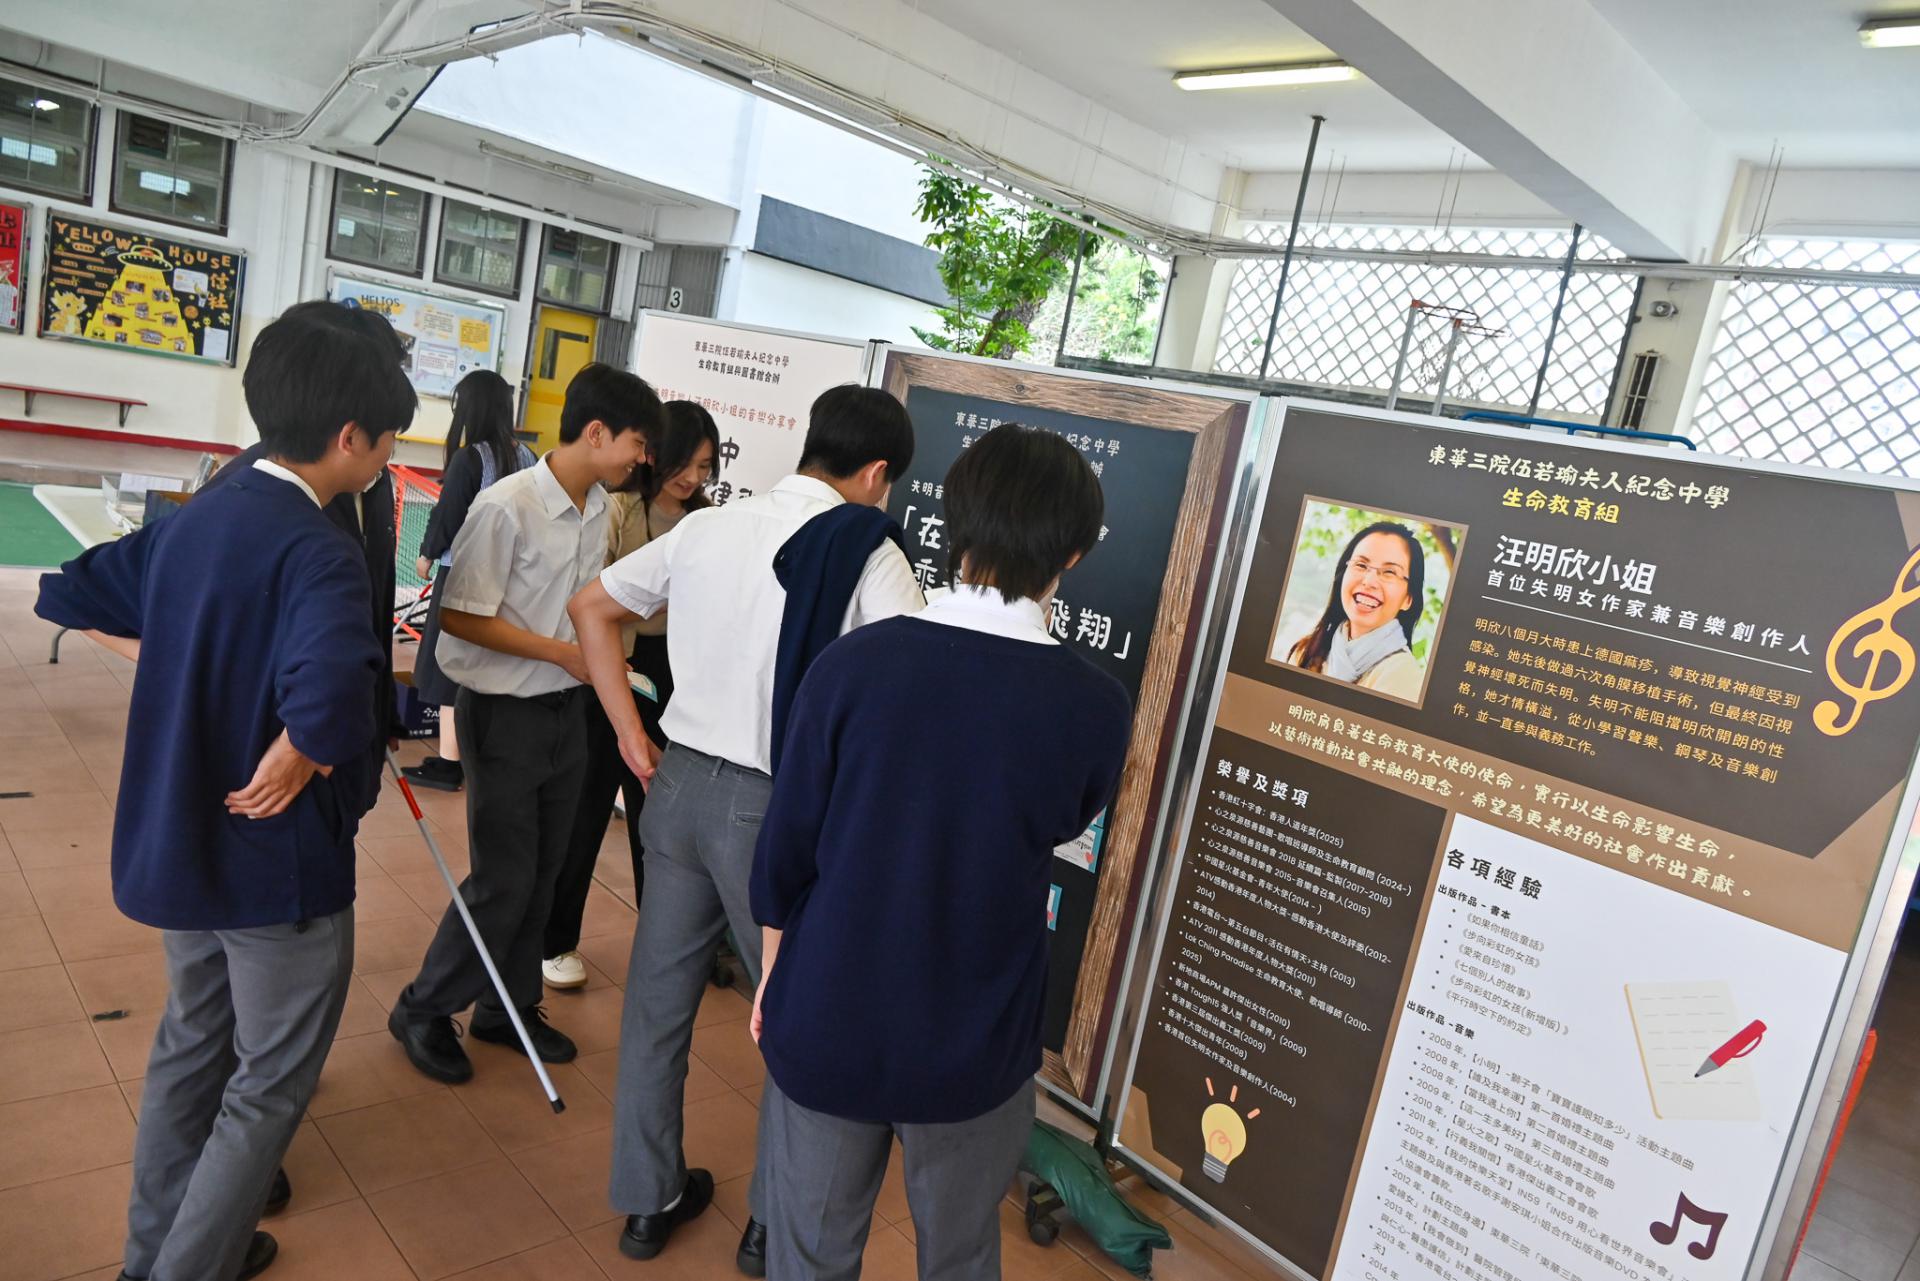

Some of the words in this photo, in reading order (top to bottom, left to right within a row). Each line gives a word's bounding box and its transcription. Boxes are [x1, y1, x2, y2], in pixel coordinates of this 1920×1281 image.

[54, 220, 132, 251] YELLOW
[169, 245, 231, 269] HOUSE
[361, 295, 400, 307] HELIOS
[670, 290, 681, 308] 3
[1427, 444, 1731, 511] 東華三院伍若瑜夫人紀念中學
[1500, 486, 1622, 525] 生命教育組
[1491, 534, 1659, 596] 汪明欣小姐
[1485, 569, 1815, 656] 首位失明女作家兼音樂創作人
[1216, 758, 1309, 808] 榮譽及獎項
[1445, 846, 1543, 900] 各項經驗
[1188, 917, 1202, 928] ATV
[1437, 883, 1478, 907] 出版作品
[1489, 904, 1511, 921] 書本
[1184, 932, 1197, 943] Lok
[1197, 938, 1220, 957] Ching
[1220, 950, 1255, 973] Paradise
[1406, 999, 1445, 1026] 出版作品
